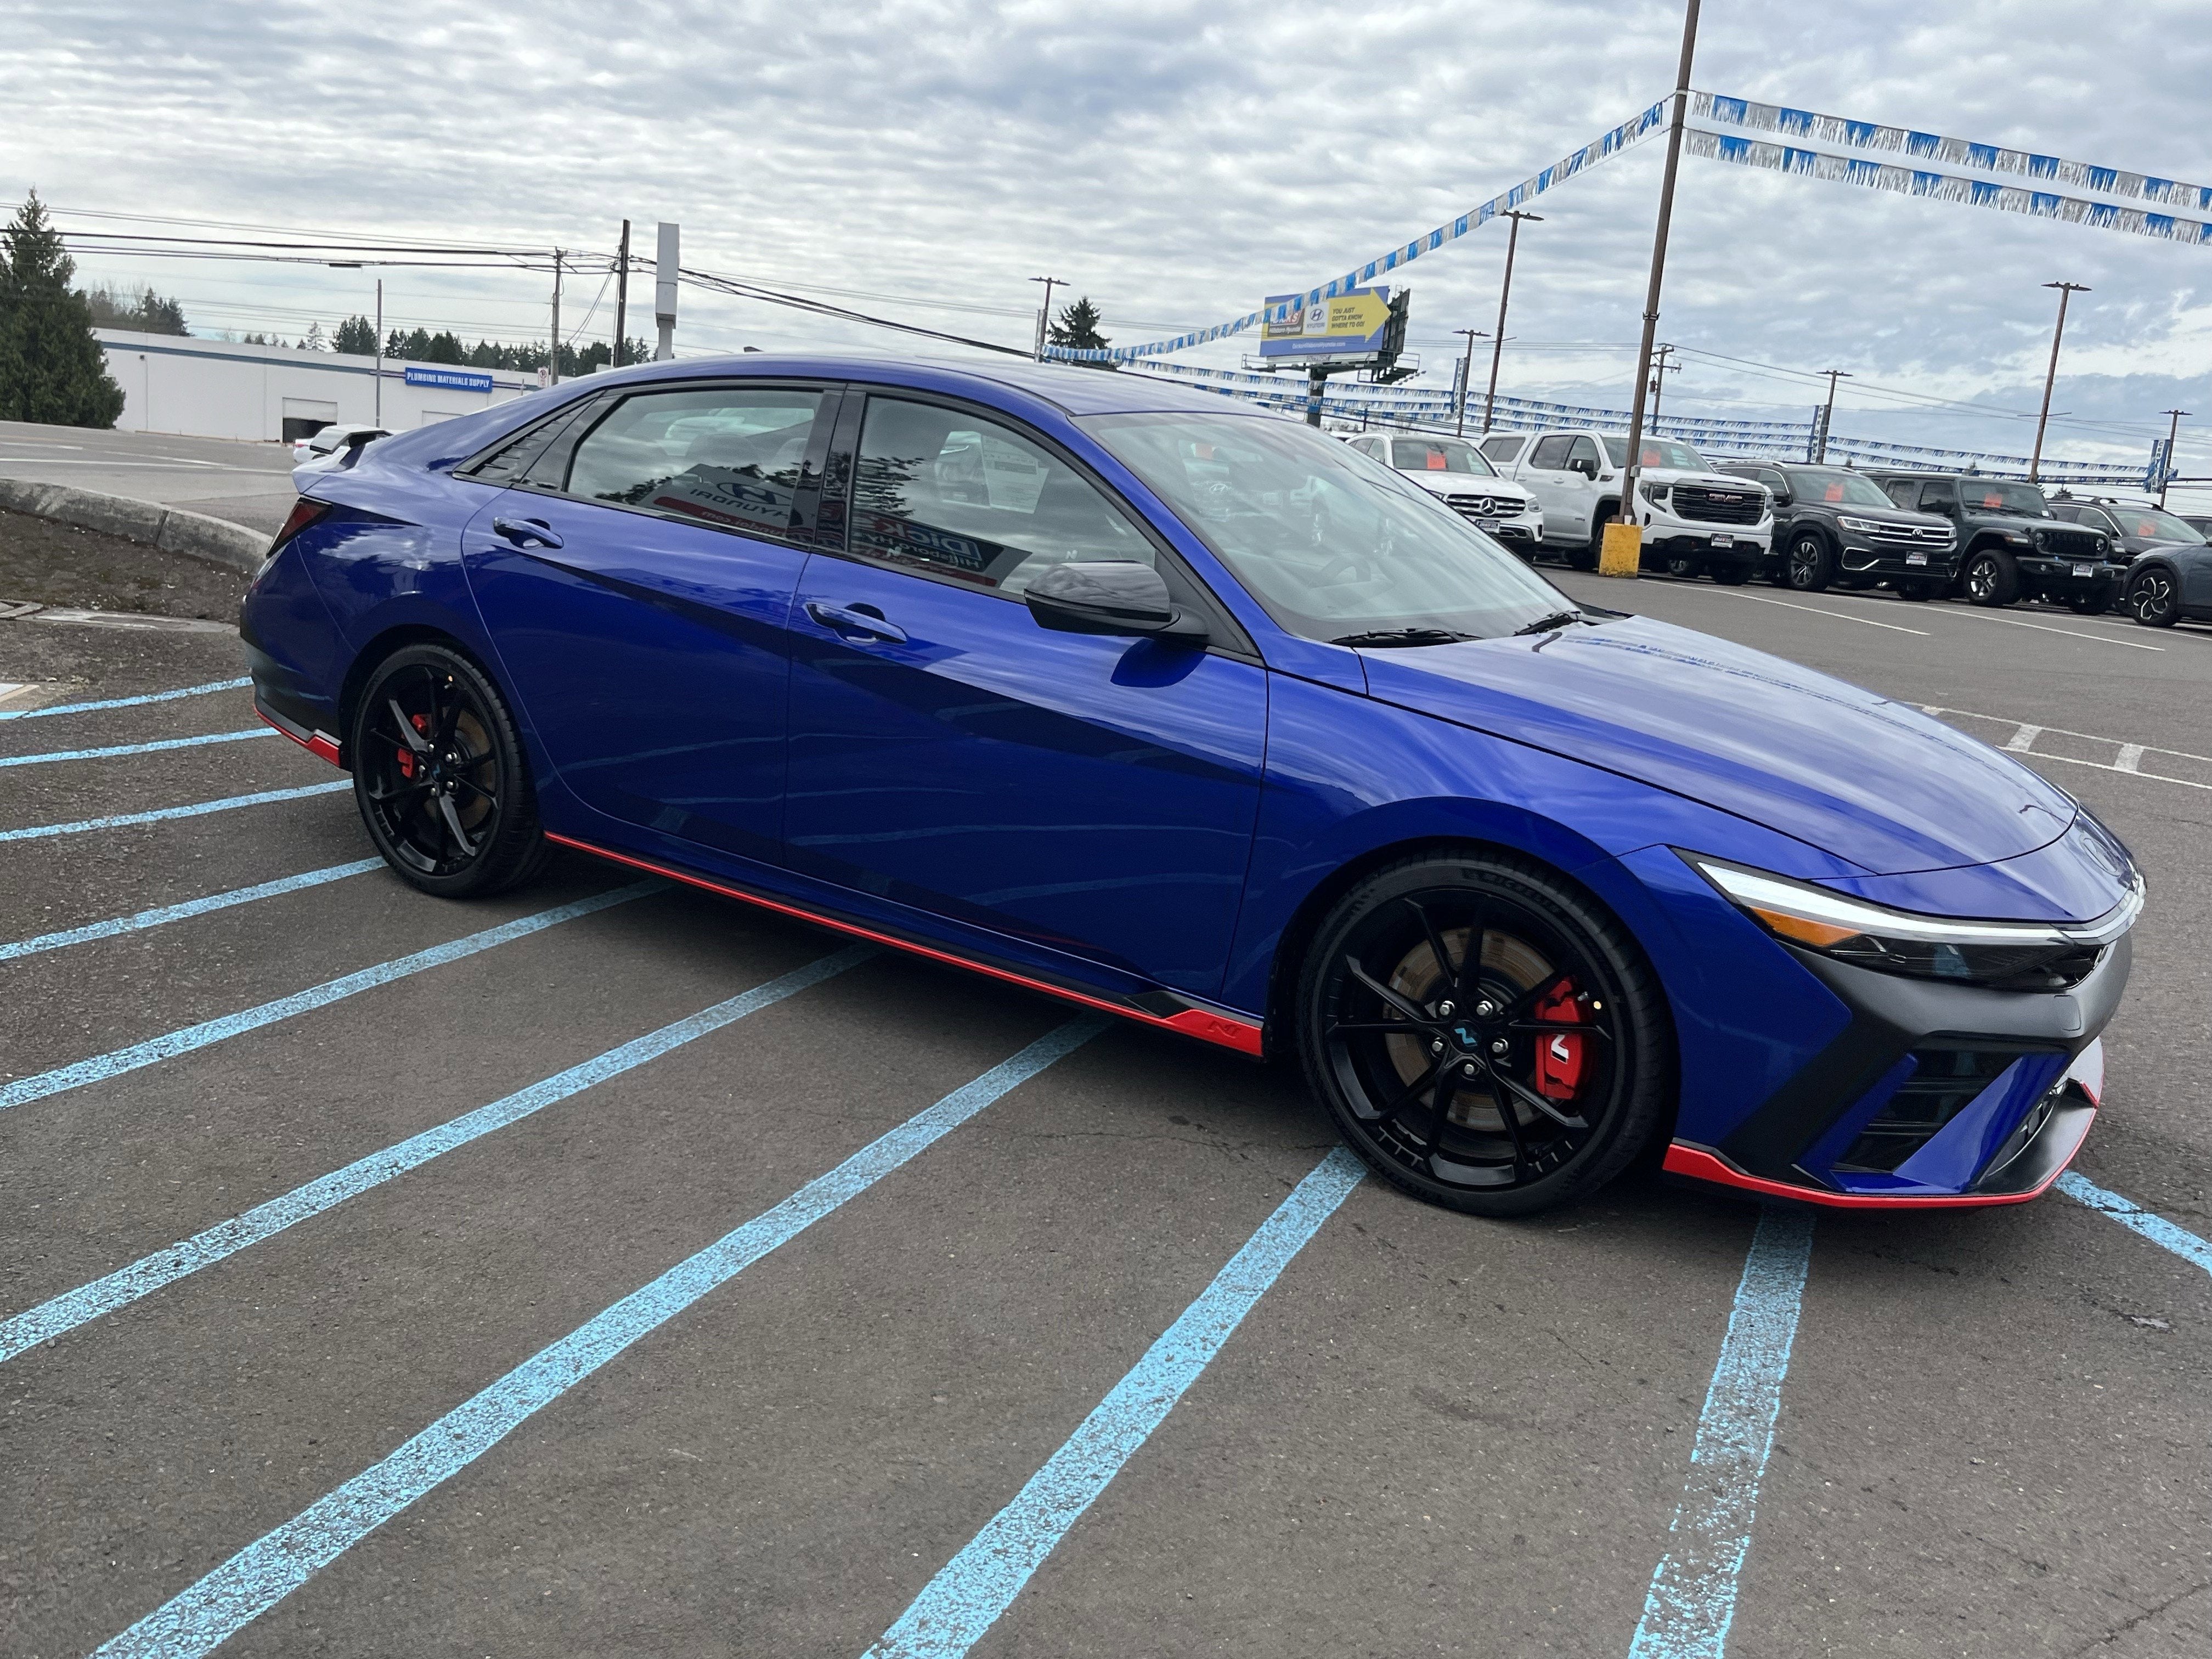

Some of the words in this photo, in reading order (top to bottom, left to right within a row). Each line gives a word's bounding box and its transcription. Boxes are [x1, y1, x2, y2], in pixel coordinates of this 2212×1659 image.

[407, 372, 436, 383] PLUMBING
[437, 375, 468, 386] MATERIALS
[469, 378, 490, 388] SUPPLY
